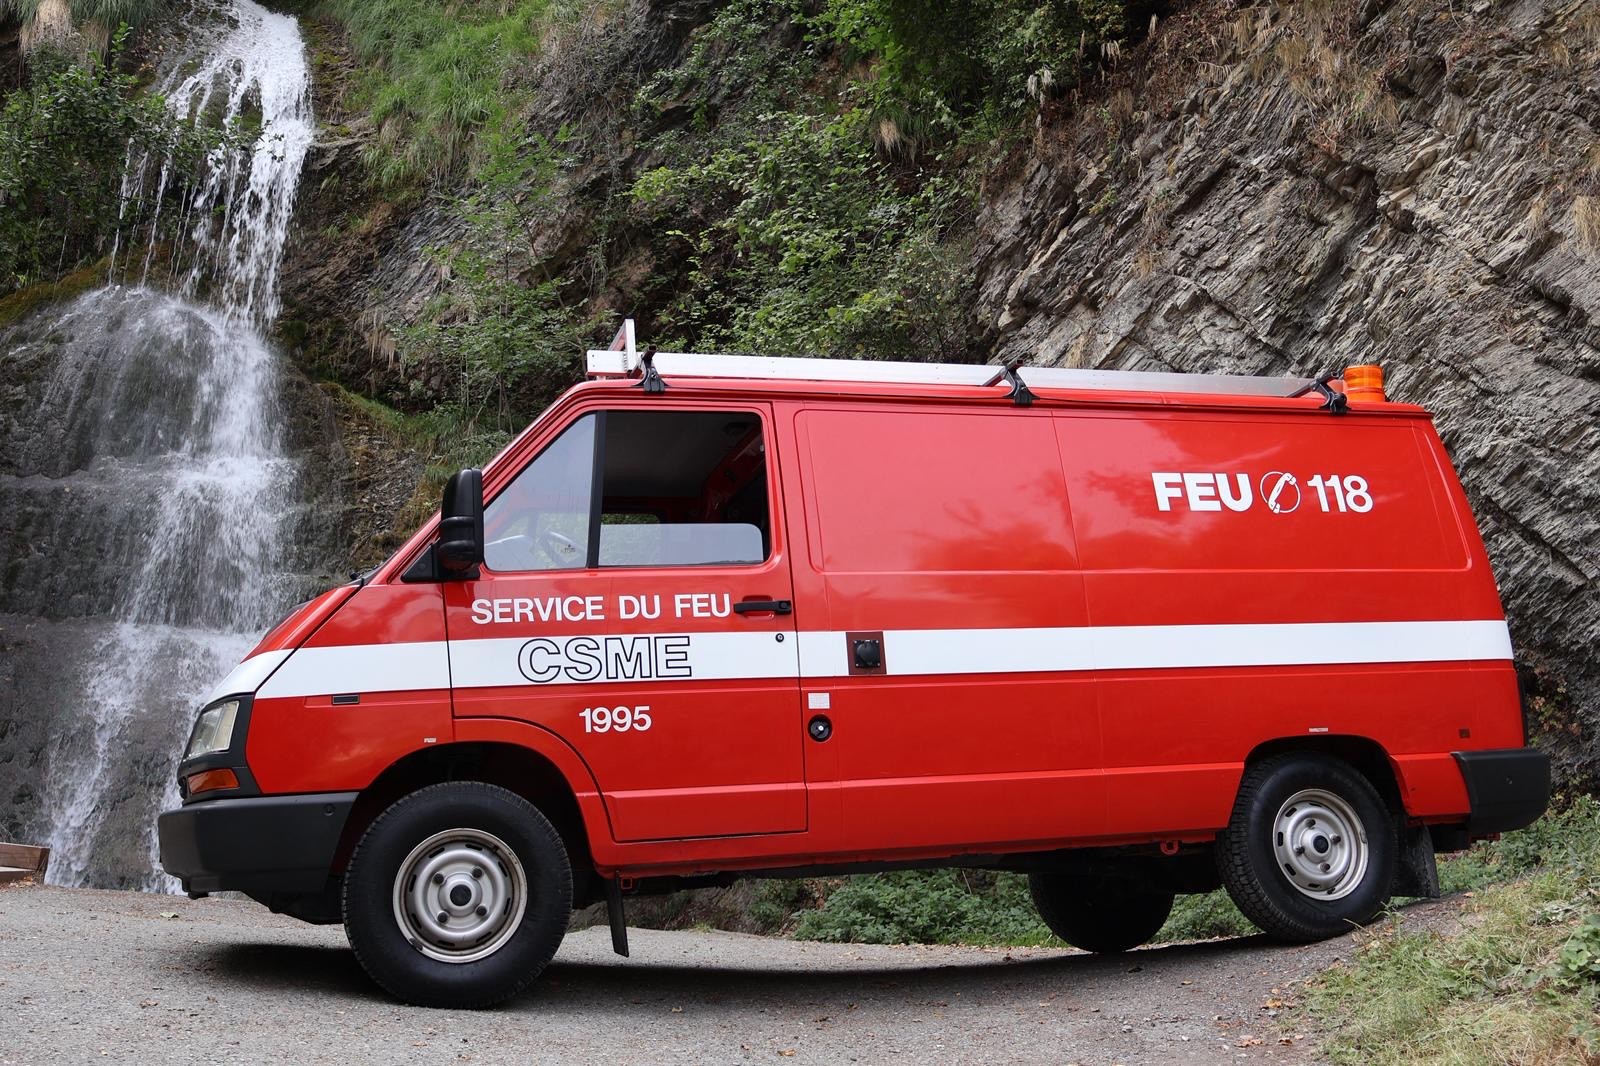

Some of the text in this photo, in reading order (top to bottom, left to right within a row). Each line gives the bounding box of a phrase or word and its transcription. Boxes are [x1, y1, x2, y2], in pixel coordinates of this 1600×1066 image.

[1151, 472, 1374, 513] FEU 118
[471, 593, 731, 625] SERVICE DU FEU
[517, 635, 692, 683] CSME
[578, 705, 652, 733] 1995
